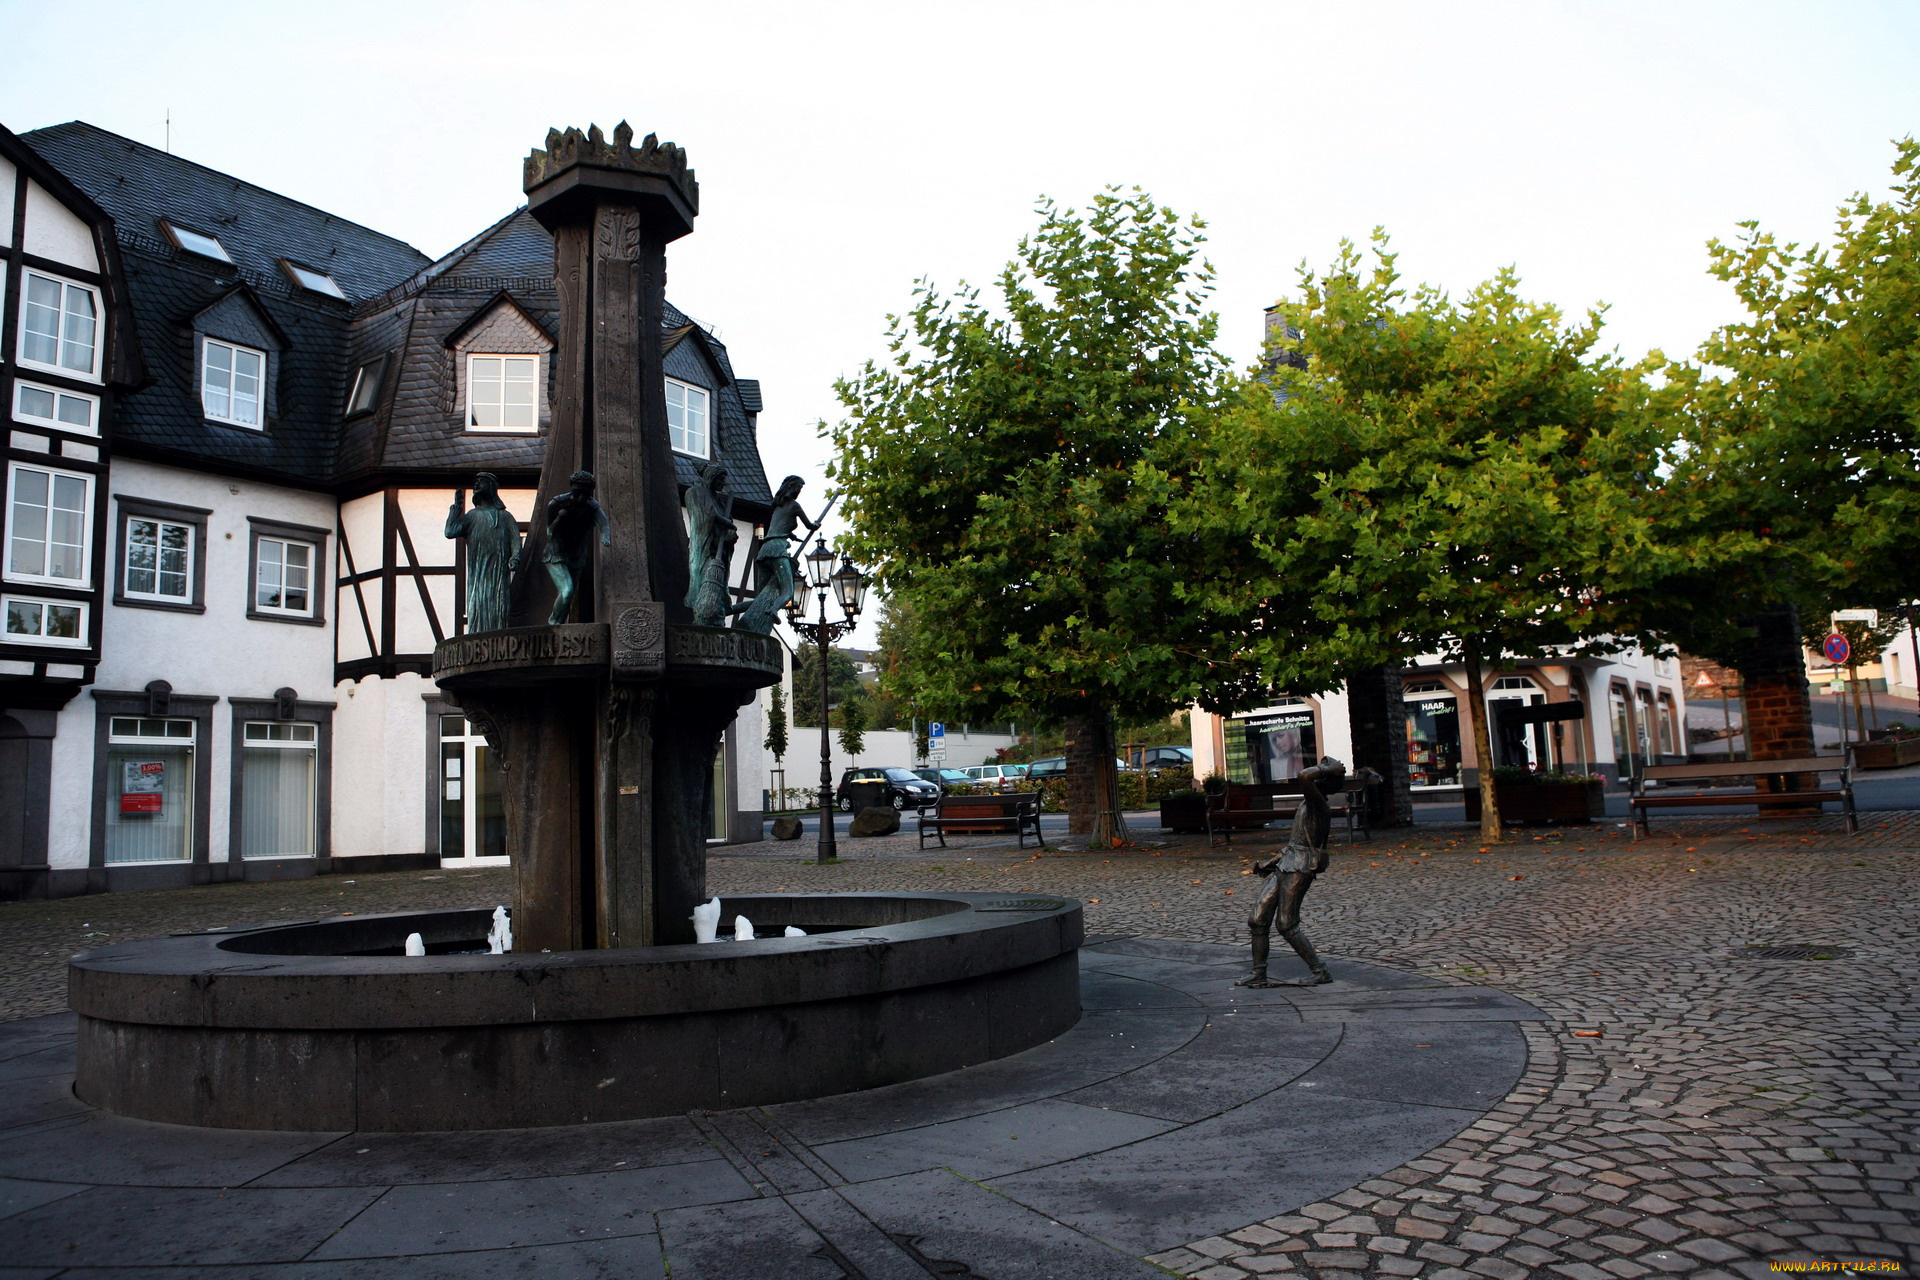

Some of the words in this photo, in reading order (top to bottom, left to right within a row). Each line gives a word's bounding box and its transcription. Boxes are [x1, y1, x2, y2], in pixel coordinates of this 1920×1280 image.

[558, 632, 592, 659] EST
[1421, 701, 1445, 712] HAAR
[932, 722, 940, 736] P
